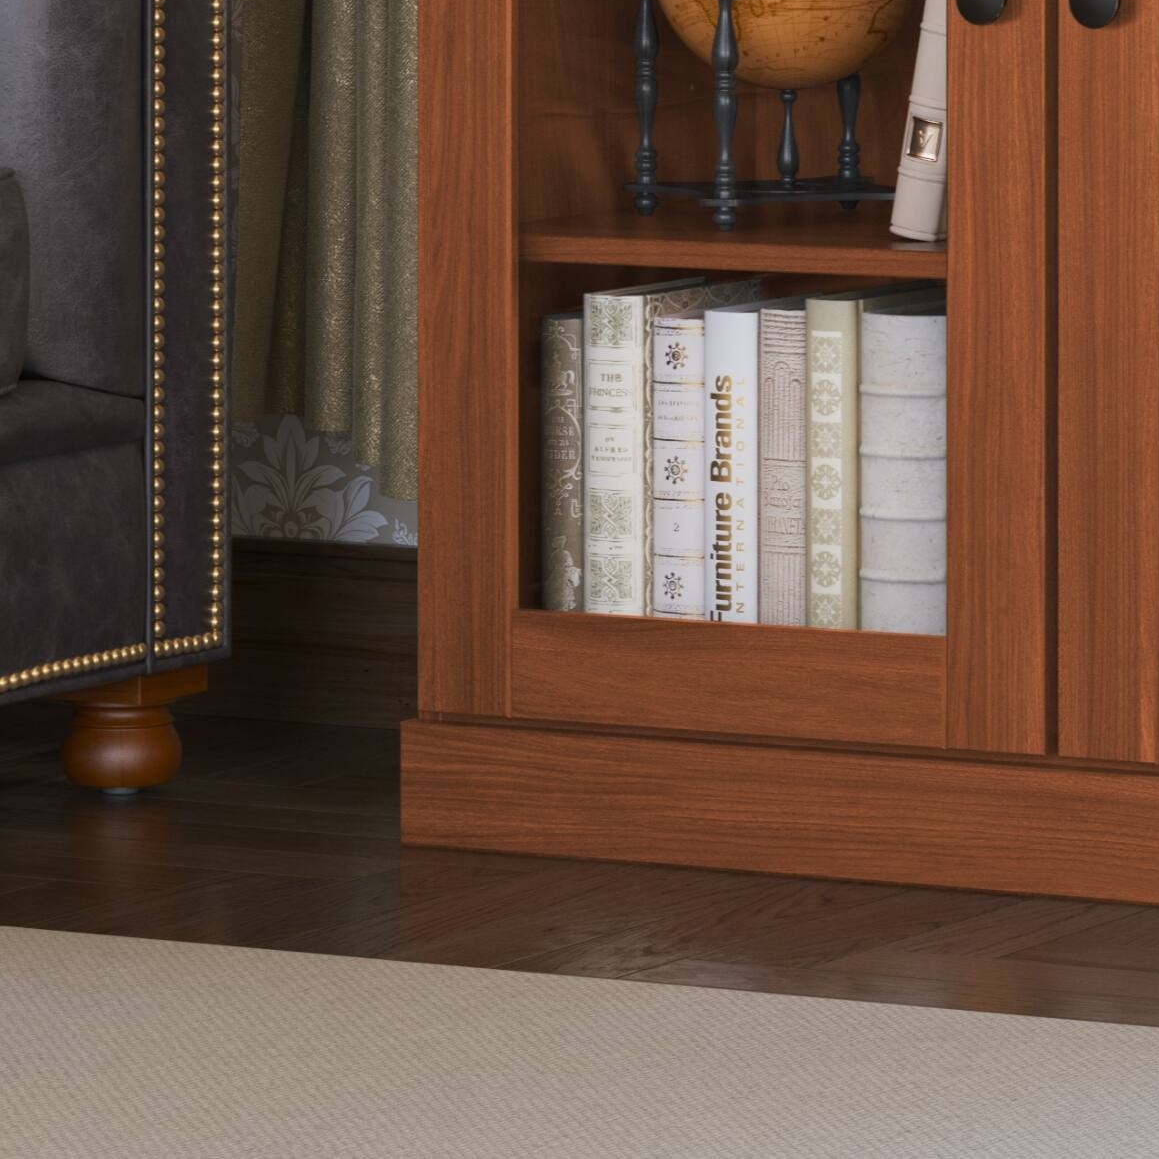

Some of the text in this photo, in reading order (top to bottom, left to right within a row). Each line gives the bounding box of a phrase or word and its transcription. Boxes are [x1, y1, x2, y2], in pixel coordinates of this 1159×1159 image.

[600, 373, 623, 382] THE
[709, 375, 733, 483] Brands
[673, 522, 680, 532] 2
